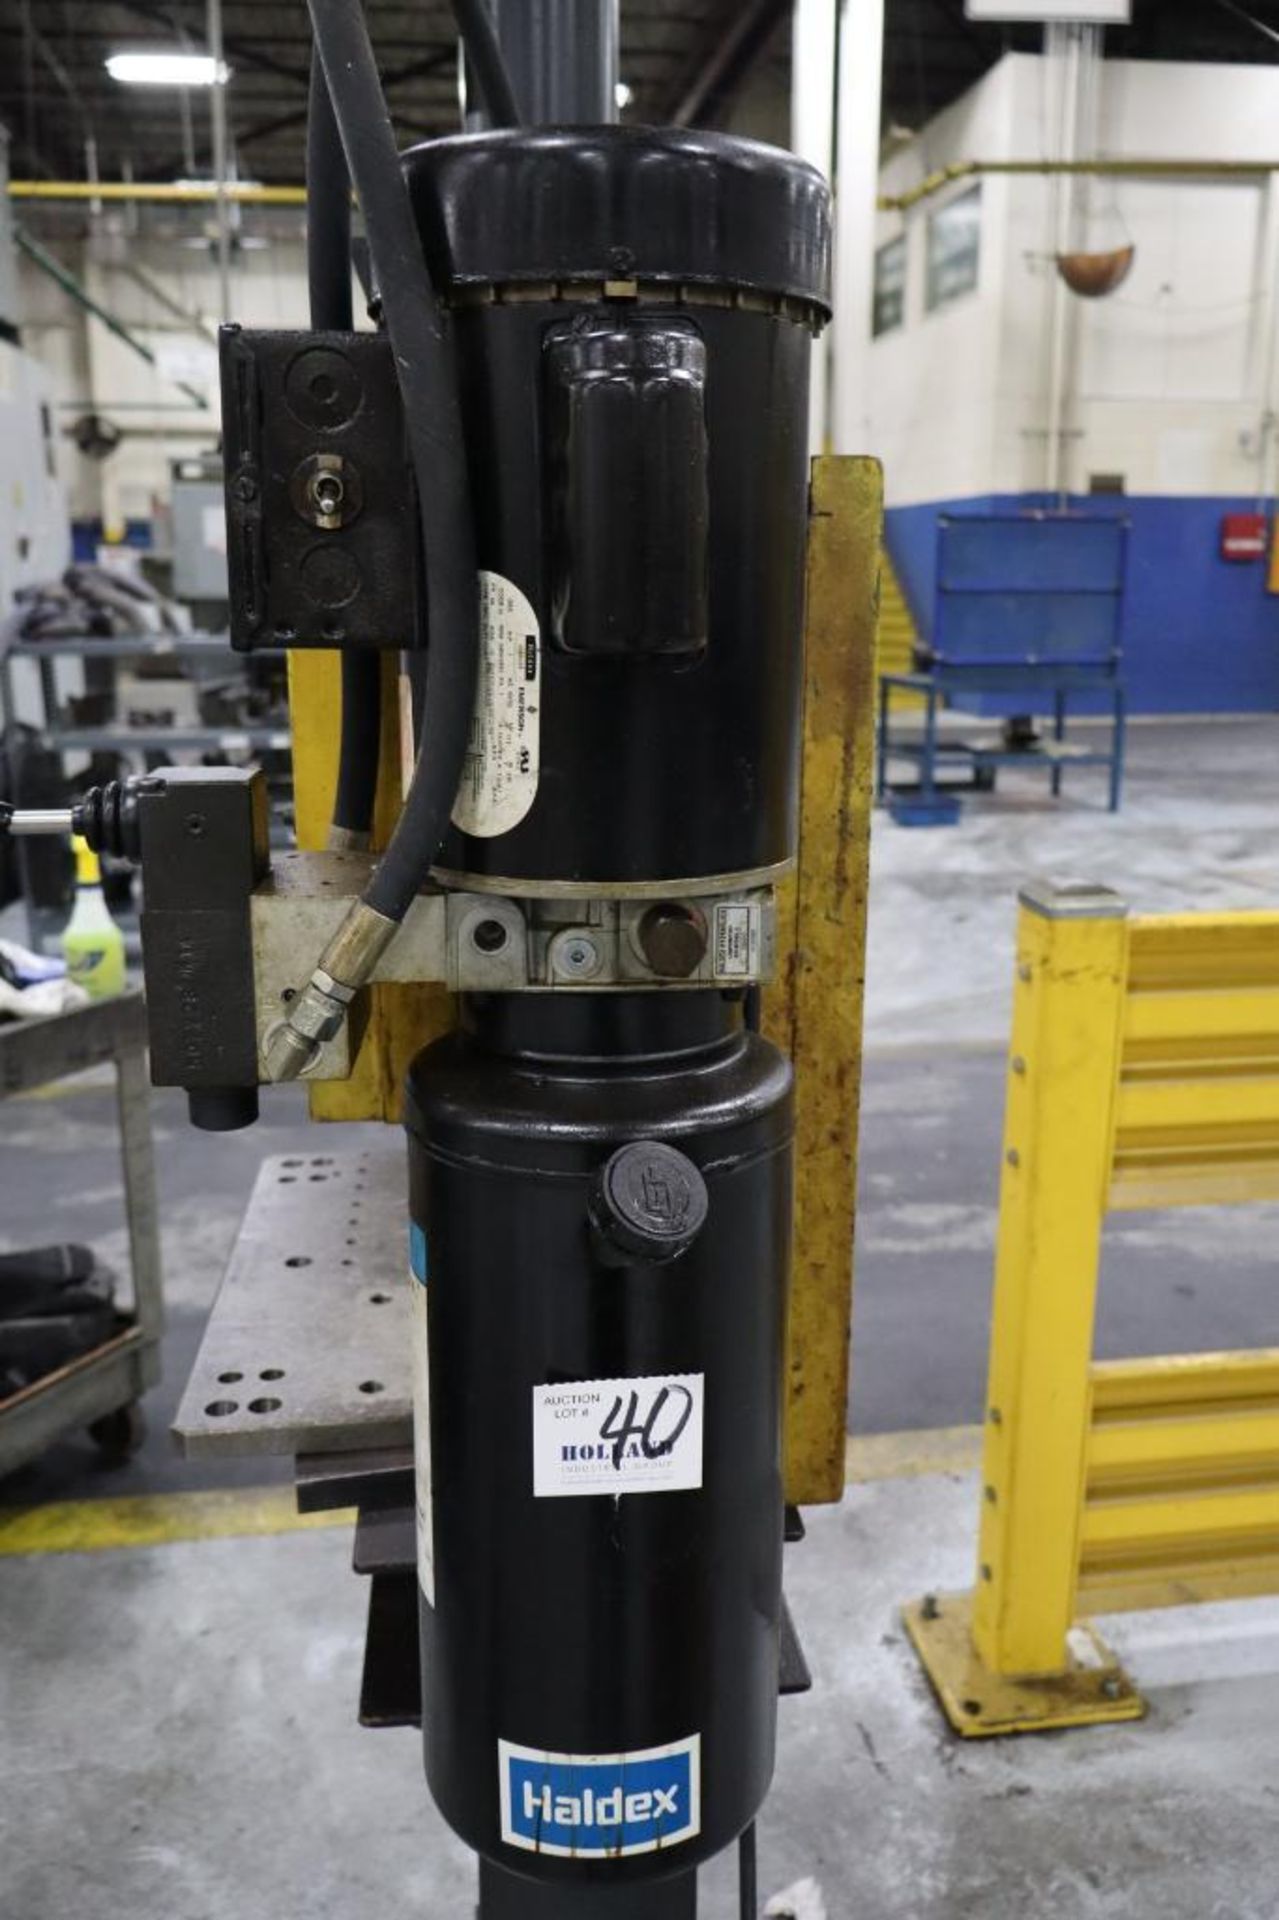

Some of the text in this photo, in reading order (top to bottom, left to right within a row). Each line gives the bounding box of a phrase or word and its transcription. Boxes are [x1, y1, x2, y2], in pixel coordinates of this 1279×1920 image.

[544, 1392, 600, 1405] AUCTION
[554, 1410, 579, 1420] LOT
[599, 1384, 694, 1471] 40
[561, 1441, 674, 1462] HOLA
[523, 1780, 679, 1827] Haldex
